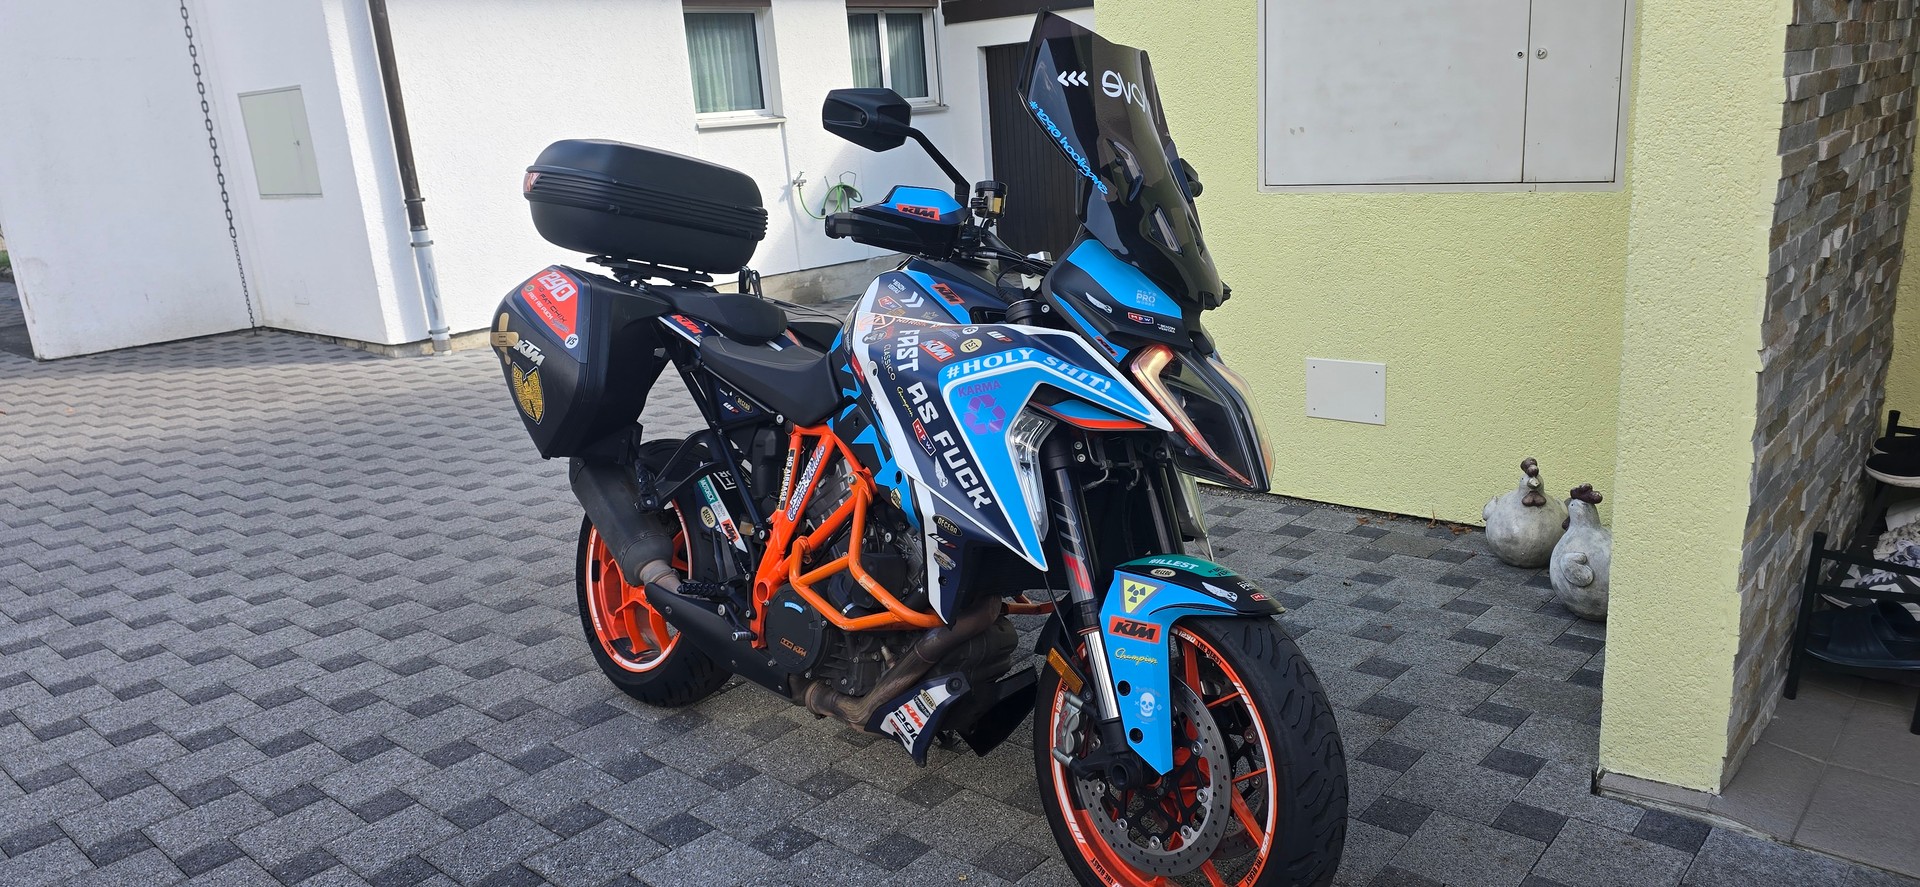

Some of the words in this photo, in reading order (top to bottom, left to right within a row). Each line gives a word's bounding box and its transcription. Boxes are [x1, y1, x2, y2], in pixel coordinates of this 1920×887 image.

[1059, 136, 1108, 195] hooligans
[902, 207, 935, 218] KTM
[1136, 293, 1156, 304] PRO
[671, 314, 702, 334] KTM
[513, 340, 546, 366] KTM
[883, 344, 896, 380] CLASSICO
[897, 330, 920, 372] FAST
[920, 340, 953, 361] KTM
[947, 349, 1034, 380] #HOLY
[1042, 355, 1112, 393] SHIT!
[958, 379, 1002, 397] KARMA
[907, 382, 939, 424] AS
[932, 430, 992, 510] FUCK
[700, 479, 716, 502] MOTOREX
[1113, 619, 1156, 640] KTM
[1114, 648, 1158, 666] Champion
[903, 704, 924, 728] KTM
[1090, 857, 1106, 876] BEAST
